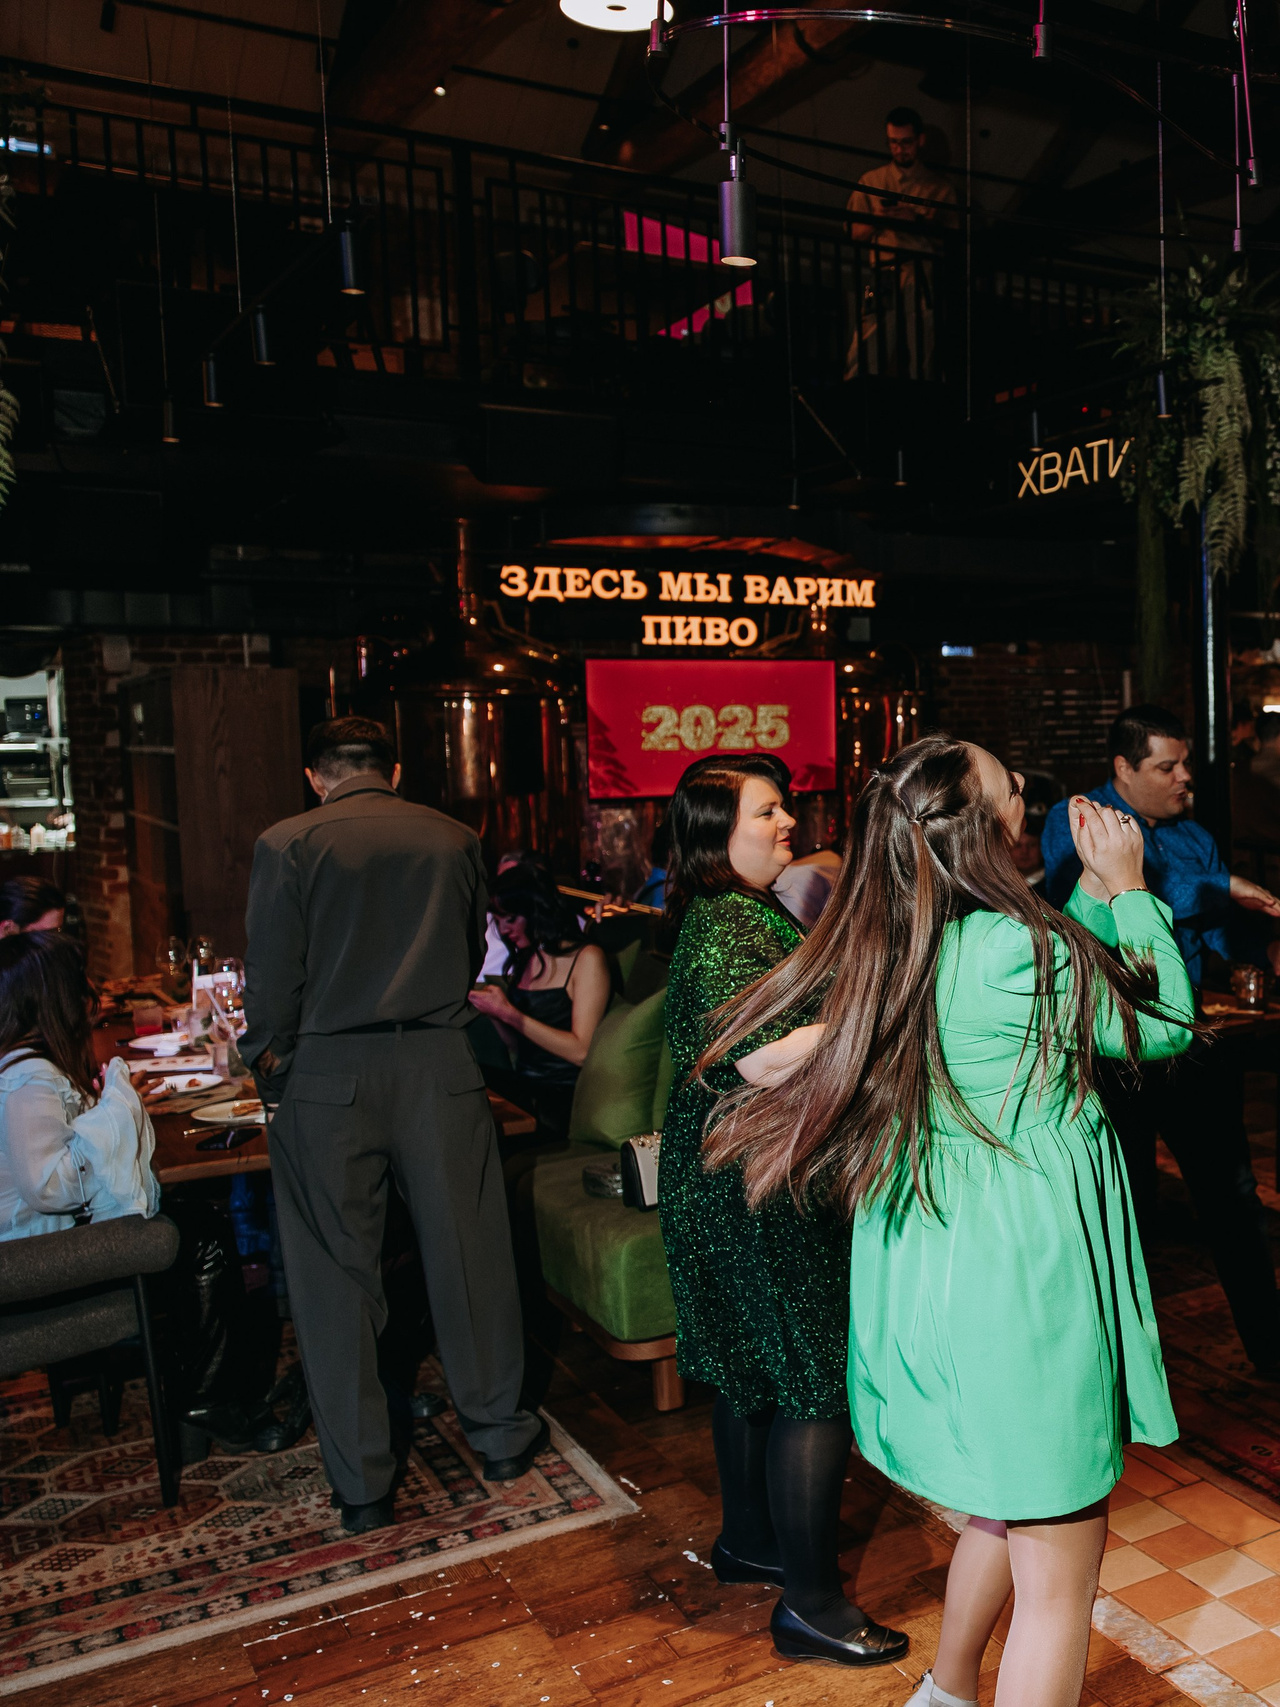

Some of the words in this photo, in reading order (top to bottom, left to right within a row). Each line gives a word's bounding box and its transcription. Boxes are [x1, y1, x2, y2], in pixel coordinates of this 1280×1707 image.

[500, 565, 647, 602] ЗДЕСЬ
[659, 571, 732, 603] МЫ
[744, 574, 876, 608] ВАРИМ
[641, 615, 758, 647] ПИВО
[641, 704, 790, 751] 2025
